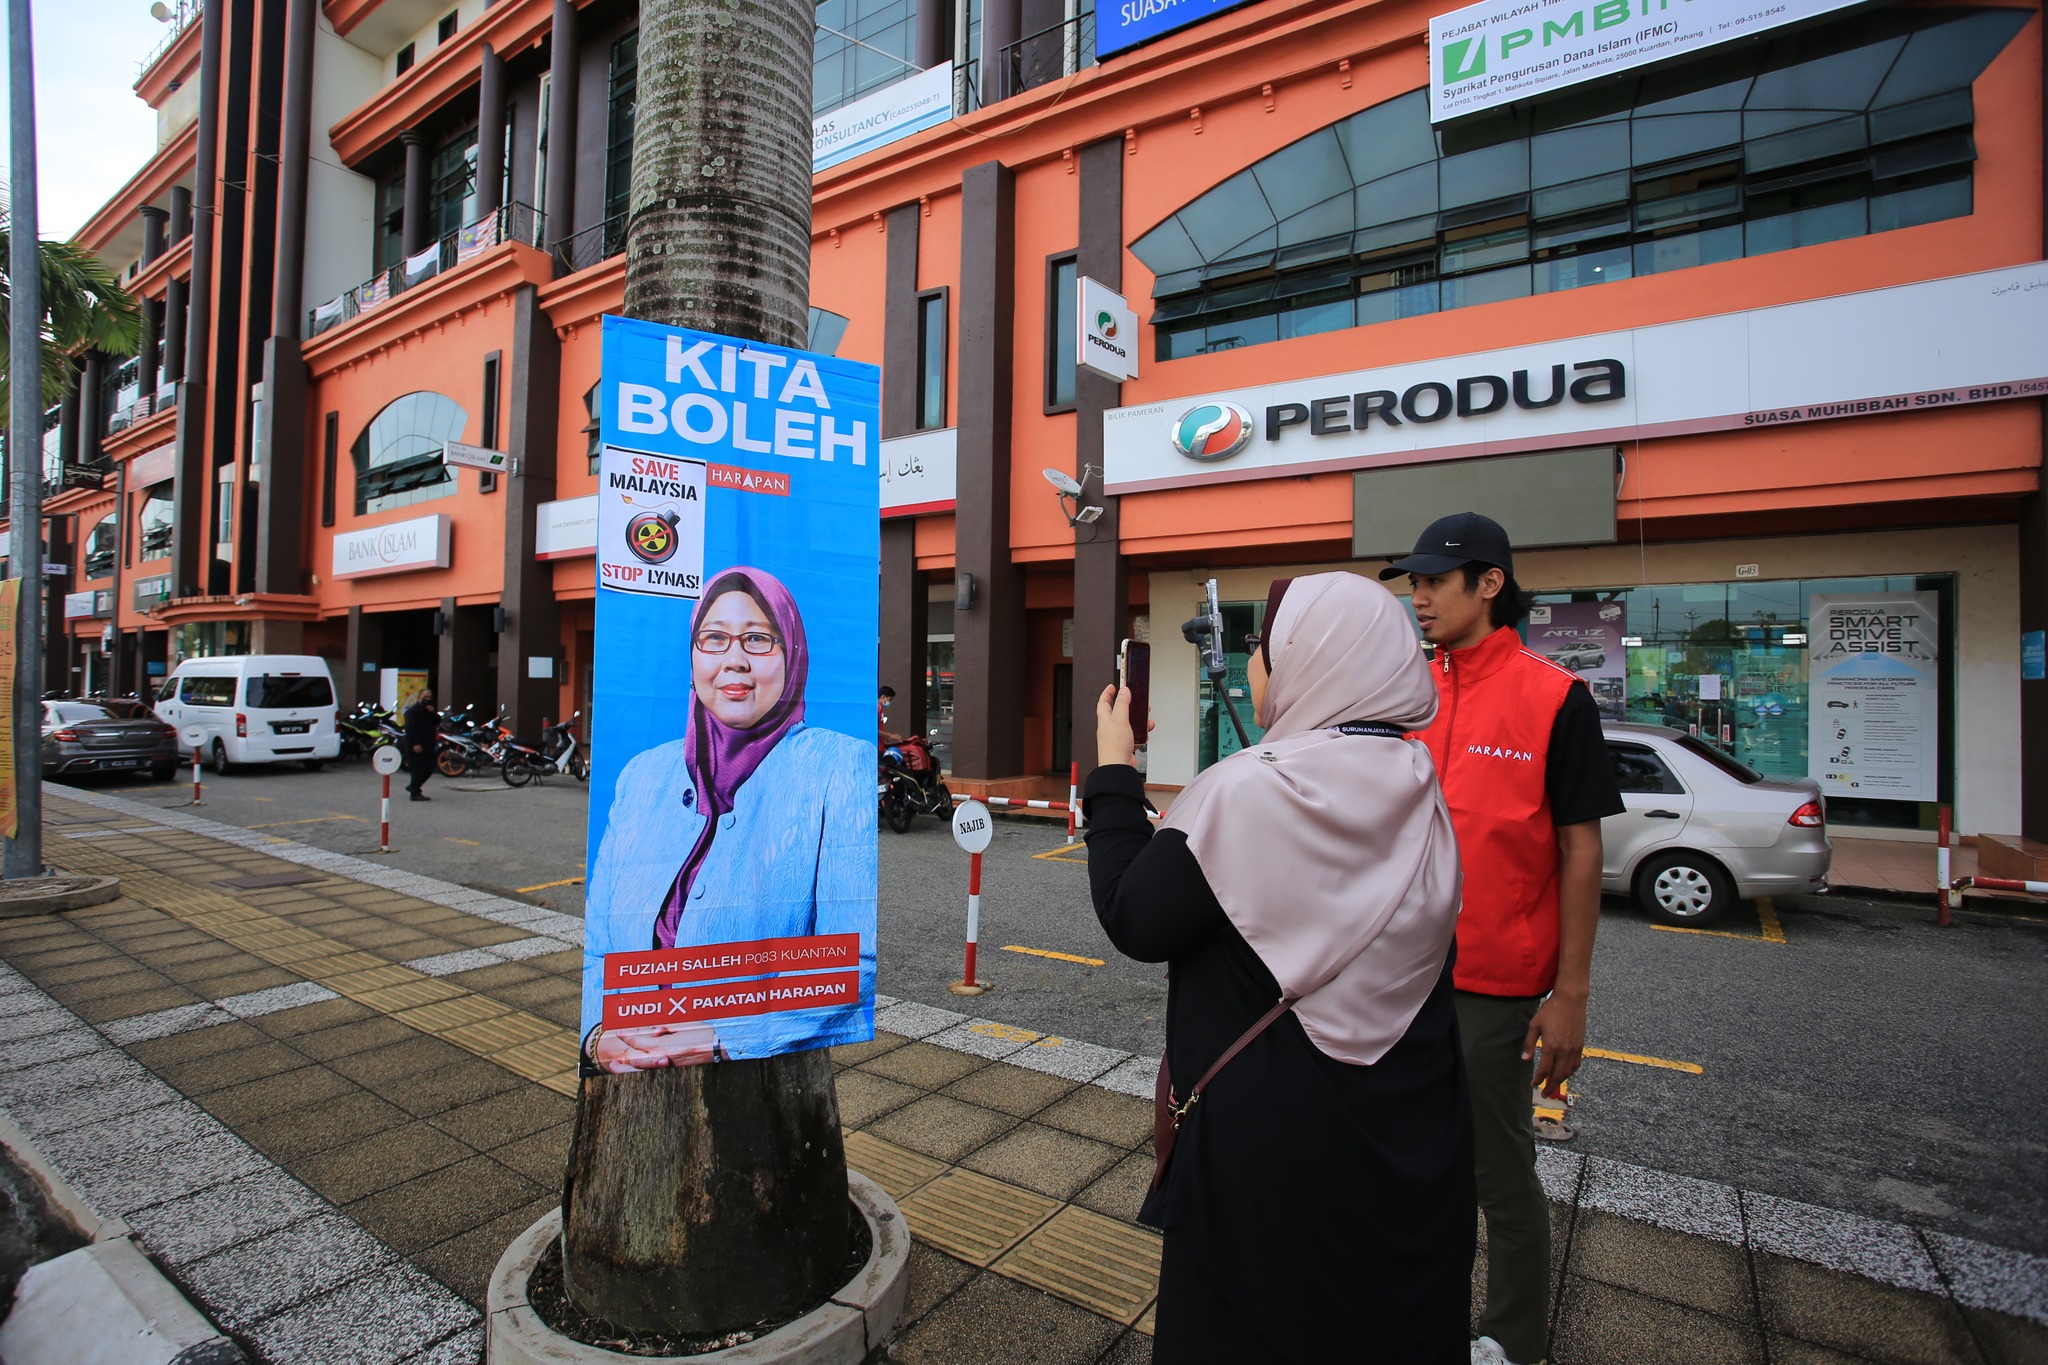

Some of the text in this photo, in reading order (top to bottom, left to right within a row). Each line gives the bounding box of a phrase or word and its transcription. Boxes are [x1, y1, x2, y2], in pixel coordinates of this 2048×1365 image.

[1441, 18, 1488, 41] PEJABAT
[1490, 2, 1539, 25] WILAYAH
[1442, 102, 1453, 110] Lot
[1473, 90, 1497, 103] Tingkat
[1505, 80, 1533, 93] Mahkota
[1535, 73, 1561, 85] Square,
[1562, 65, 1581, 77] Jalan
[1582, 57, 1613, 71] Mahkota,
[1616, 49, 1638, 61] 25000
[1638, 40, 1673, 54] Kuantan,
[1674, 29, 1704, 44] Pahang
[1735, 13, 1764, 26] 09-515
[1765, 5, 1787, 17] 8545
[1442, 20, 1679, 100] Syarikat Pengurusan Dana Islam (IFMC)
[665, 334, 831, 410] KITA
[1107, 406, 1165, 421] BILIK PAMERAN
[1744, 408, 1802, 426] SUASA
[1807, 396, 1909, 419] MUHIBBAH
[1914, 391, 1962, 406] SDN.
[1968, 384, 2019, 402] BHD.
[617, 381, 867, 466] BOLEH
[631, 457, 680, 481] SAVE
[711, 468, 786, 492] HARAPAN
[609, 472, 698, 502] MALAYSIA
[348, 529, 417, 561] BANK ISLAM
[601, 562, 700, 590] STOP LYNAS!
[1829, 608, 1885, 617] PERODUA
[1829, 615, 1919, 629] SMART
[1829, 628, 1902, 641] DRIVE
[1829, 641, 1919, 653] ASSIST
[1341, 726, 1385, 734] SURUHANJAYA
[1467, 744, 1533, 762] HARAPAN
[959, 818, 985, 835] NAJIB
[619, 946, 847, 977] FUZIAH SALLEH P083 KUANTAN
[617, 1001, 662, 1018] UNDI
[692, 990, 767, 1010] PAKATAN
[769, 982, 847, 1001] HARAPAN
